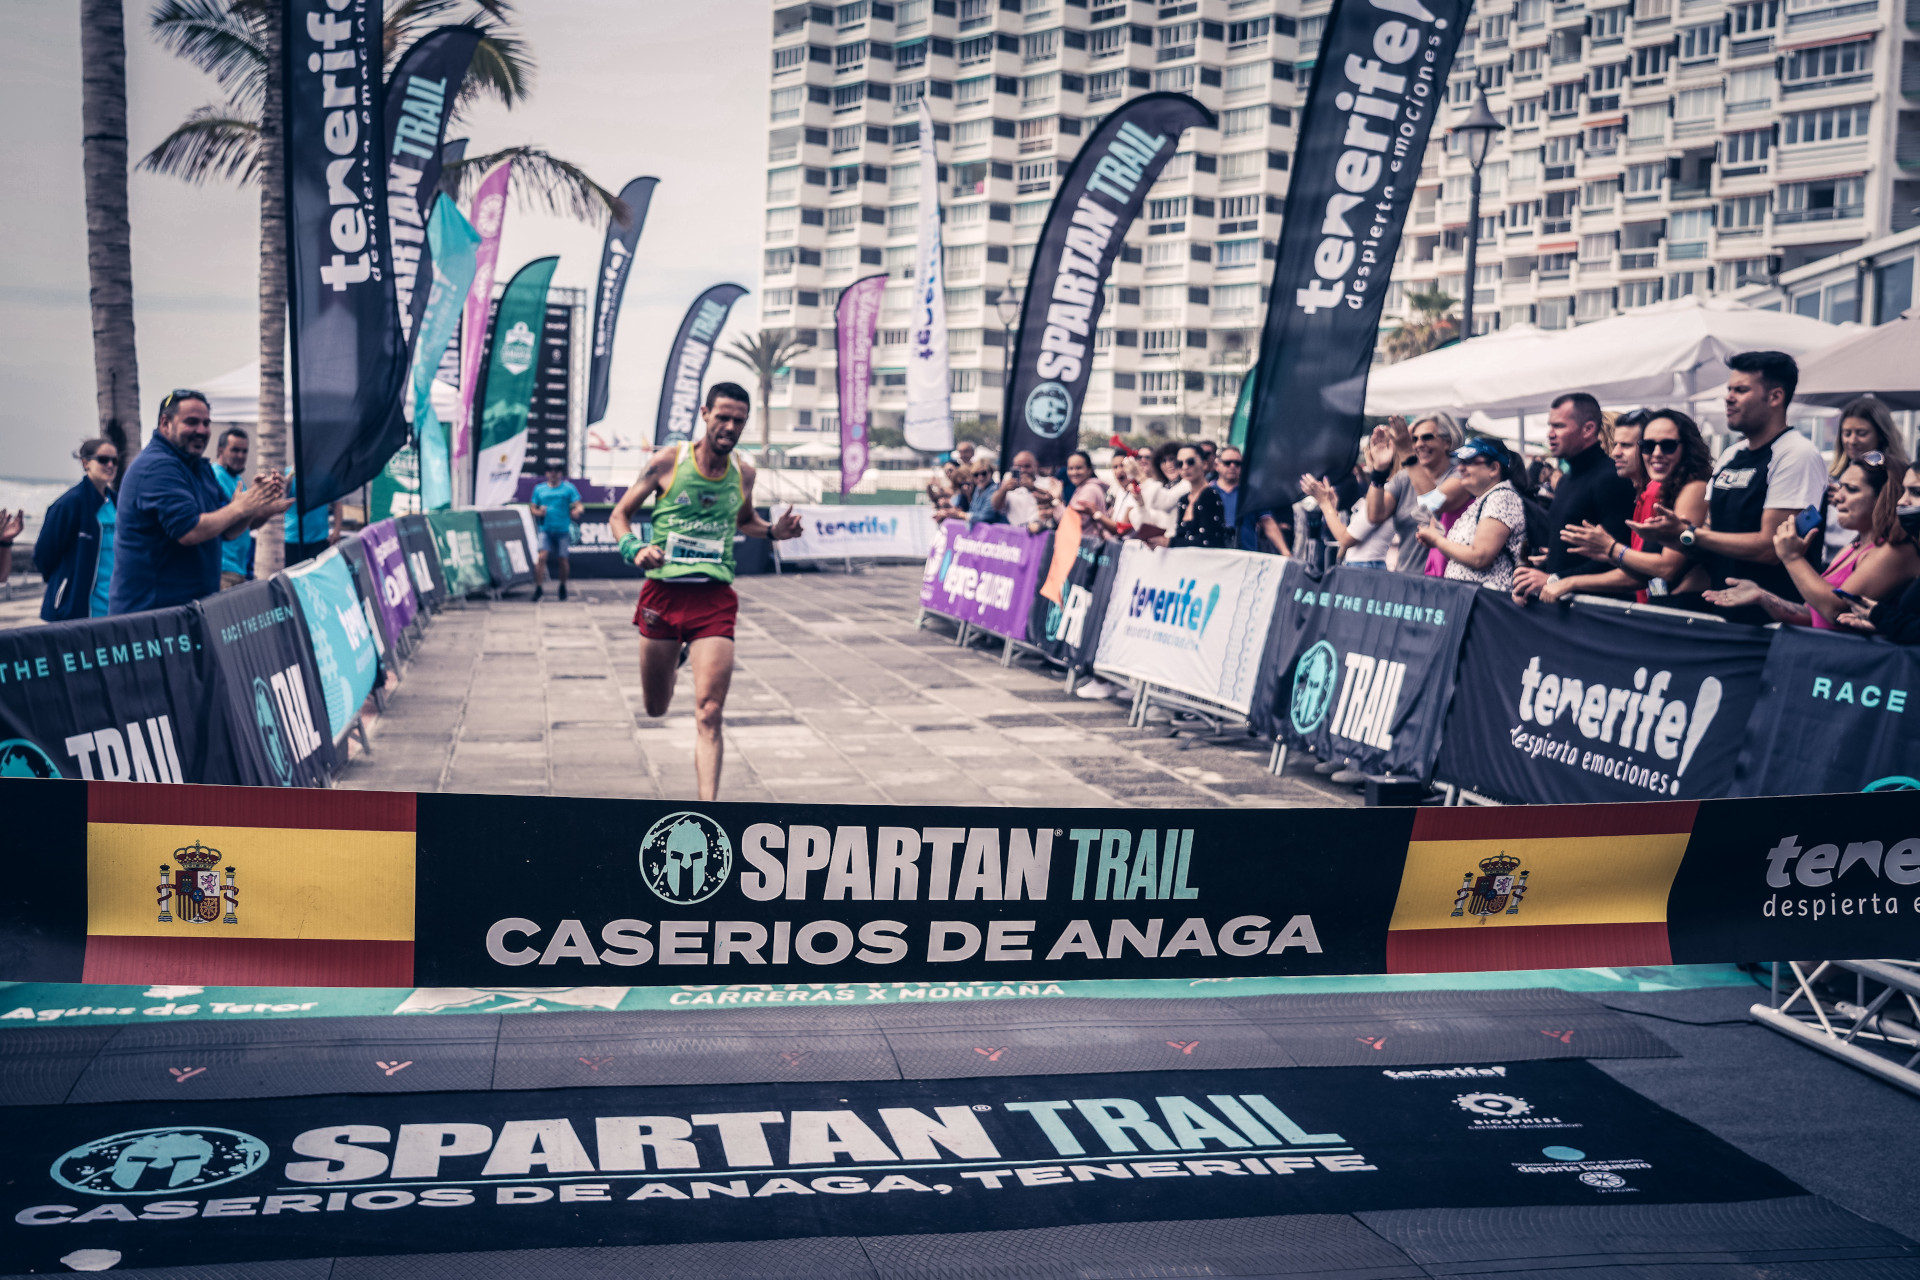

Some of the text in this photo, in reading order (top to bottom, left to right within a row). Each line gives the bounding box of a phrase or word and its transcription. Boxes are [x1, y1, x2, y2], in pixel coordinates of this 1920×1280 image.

[306, 0, 371, 291] tenerif
[392, 75, 447, 160] TRAIL
[1036, 120, 1168, 383] SPARTAN TRAIL
[1345, 185, 1395, 310] despierta
[667, 338, 711, 434] SPARTAN
[816, 516, 898, 536] tenerife!
[1129, 578, 1220, 651] tenerife!
[1334, 594, 1362, 612] THE
[0, 634, 202, 684] THE ELEMENTS.
[1330, 652, 1407, 751] TRAIL
[1518, 656, 1723, 796] tenerife!
[1811, 676, 1908, 713] RACE
[1070, 828, 1200, 901] TRAIL
[1763, 892, 1898, 921] despierta
[485, 914, 1324, 967] CASERIOS DE ANAGA
[0, 1002, 319, 1022] Aguas de Teror
[668, 989, 856, 1005] CARRERAS
[866, 987, 888, 999] X
[1005, 1094, 1347, 1156] TRAIL
[1473, 1117, 1562, 1125] BIOSPHERE
[15, 1155, 1379, 1227] CASERIOS DE ANAGA, TENERIFE
